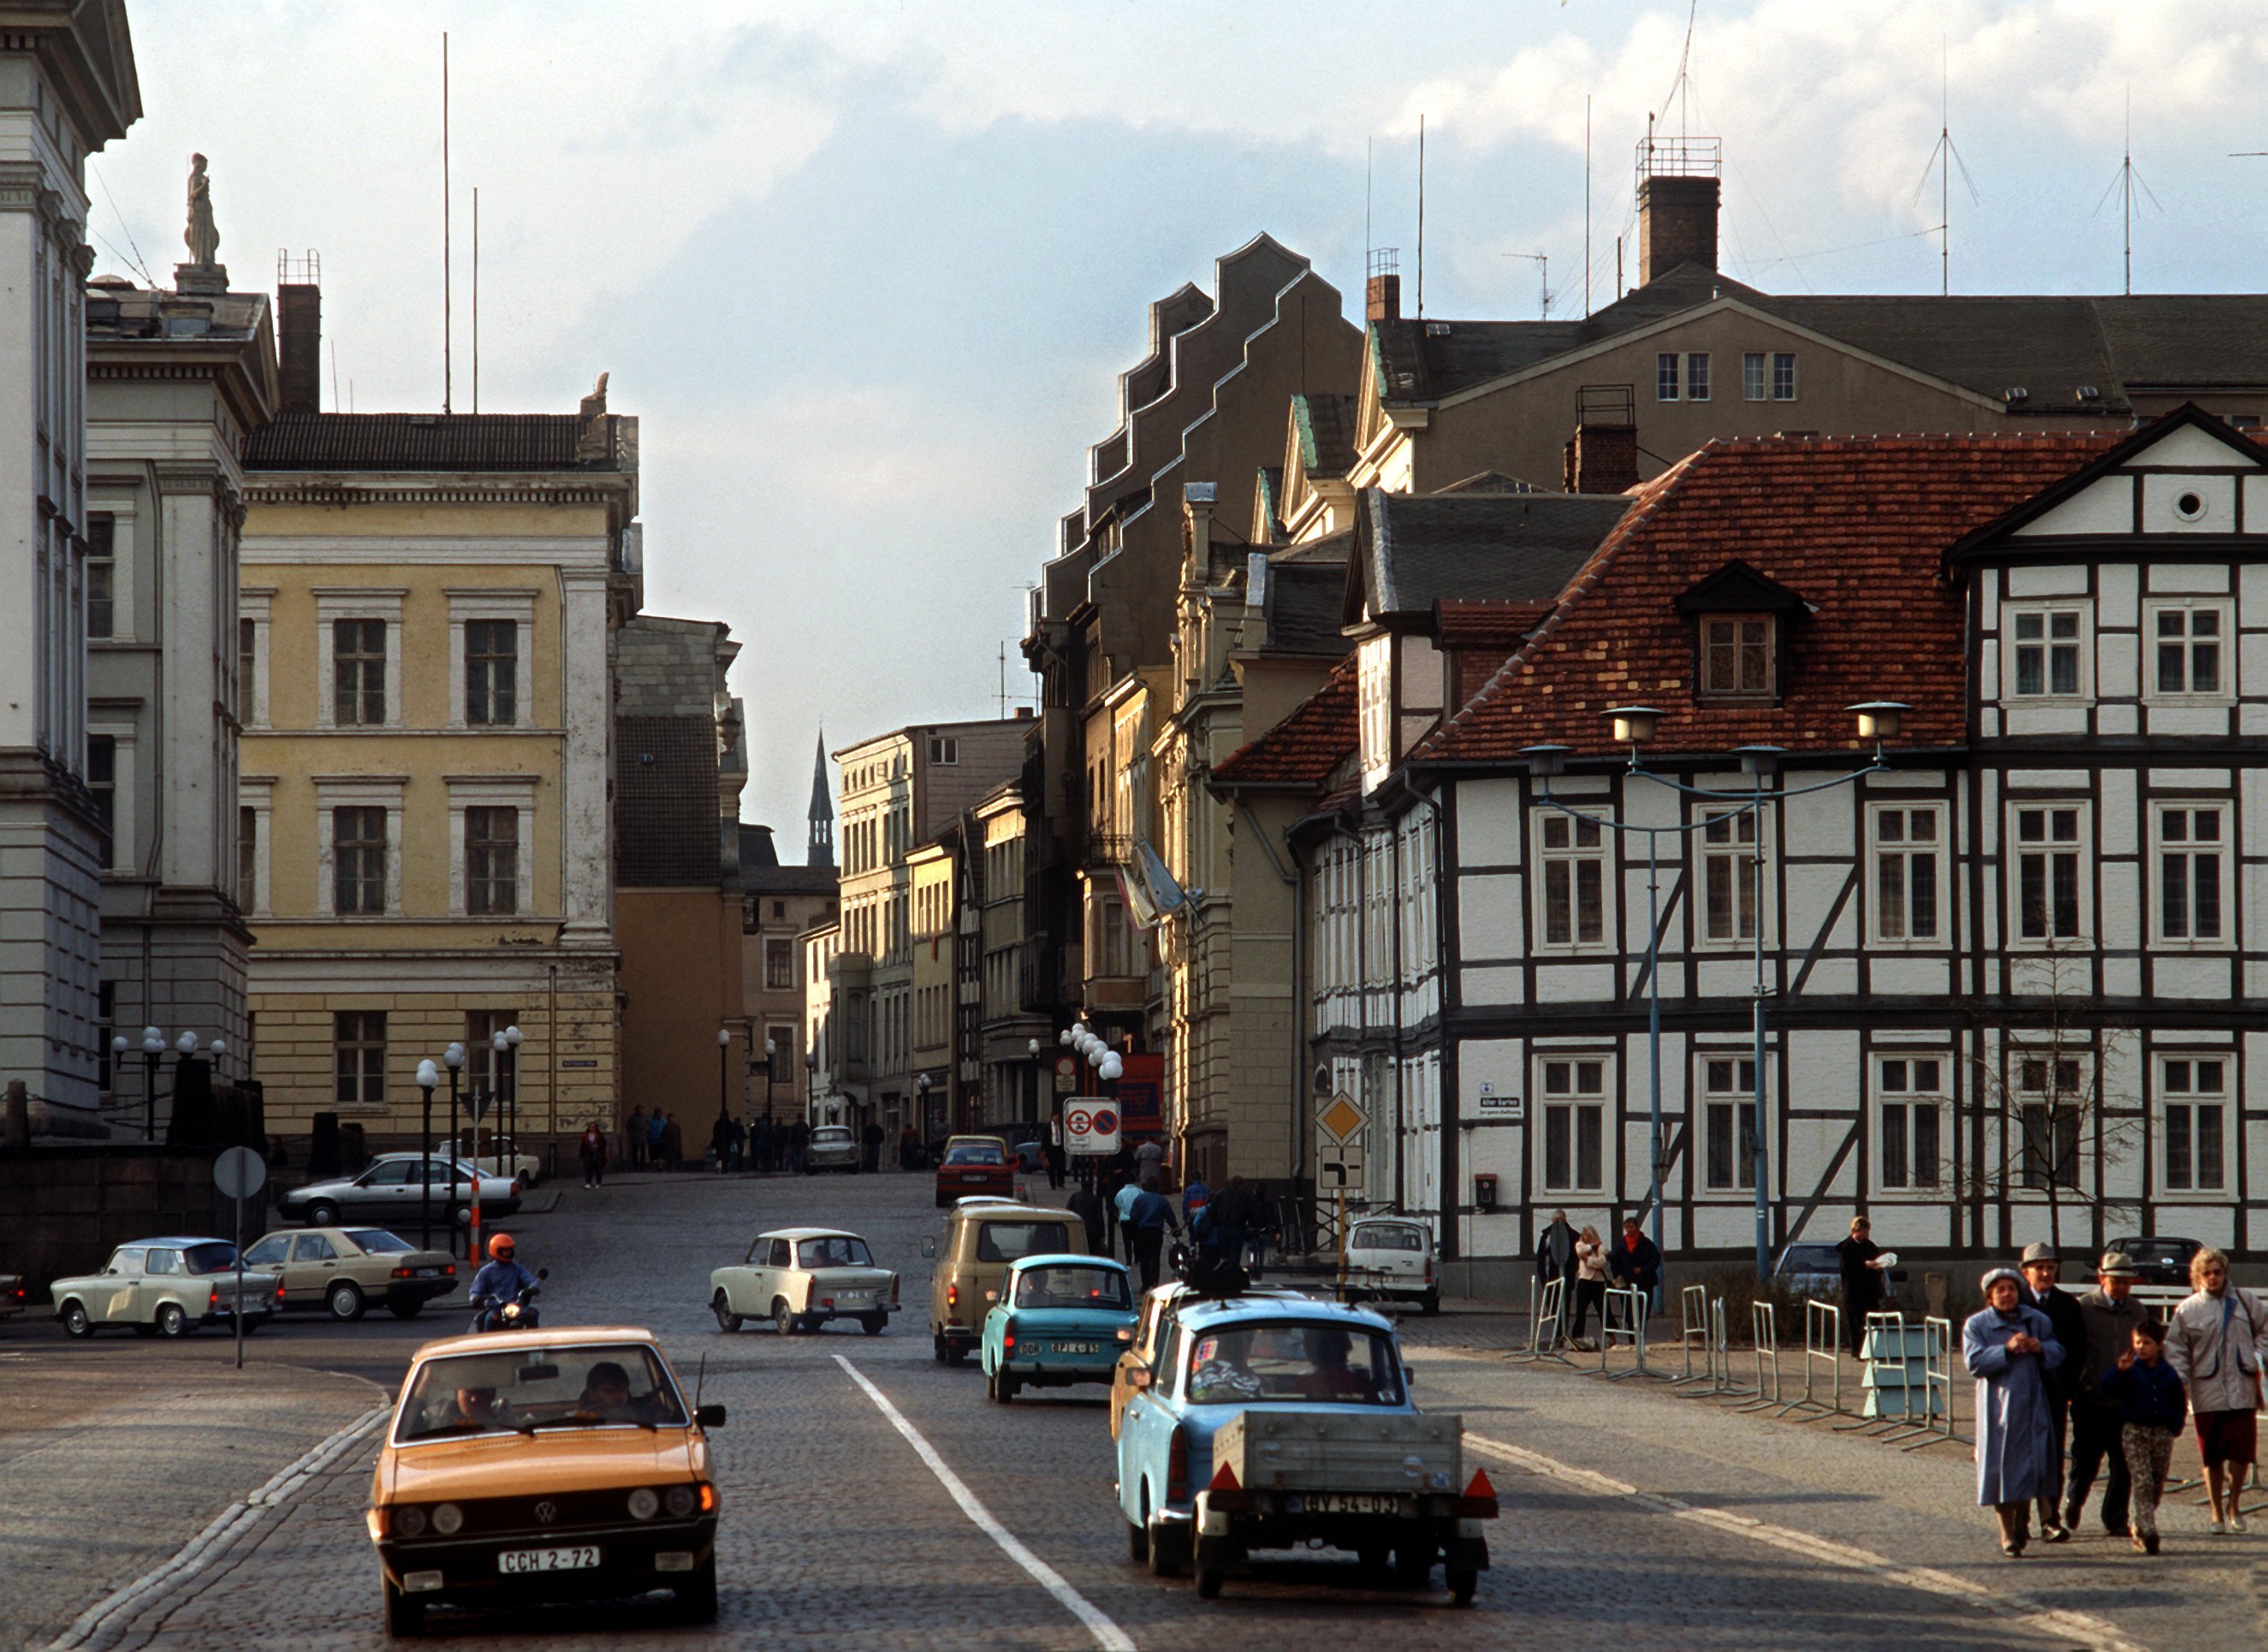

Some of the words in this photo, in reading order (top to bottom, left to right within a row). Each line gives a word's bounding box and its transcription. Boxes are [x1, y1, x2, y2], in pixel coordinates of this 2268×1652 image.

[1339, 1495, 1394, 1513] 54-03
[506, 1553, 539, 1572] CCH
[548, 1548, 594, 1571] 2-72
